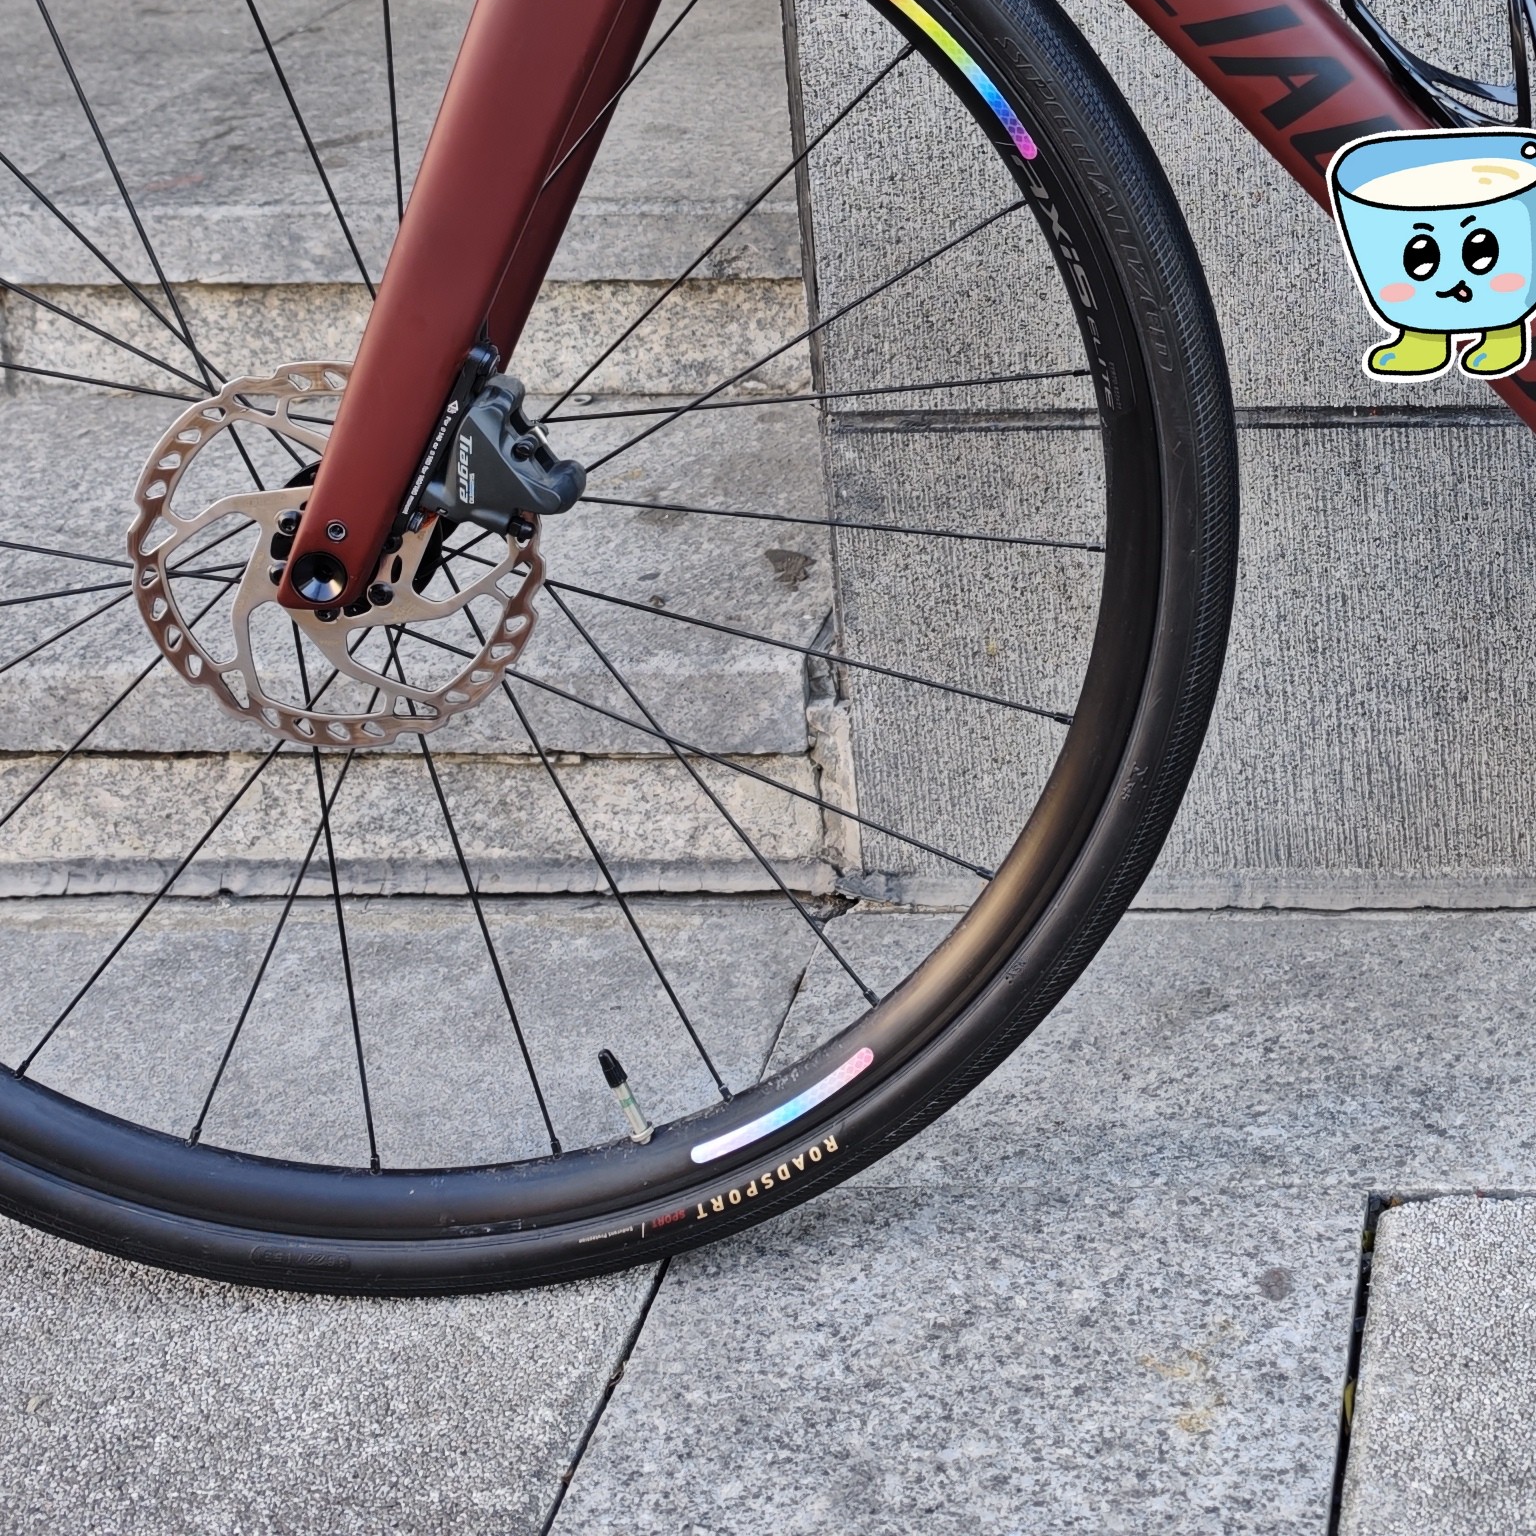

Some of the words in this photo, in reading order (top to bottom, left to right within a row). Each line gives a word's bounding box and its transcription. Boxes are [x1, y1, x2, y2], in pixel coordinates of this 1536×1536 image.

[1086, 315, 1116, 412] ELITE
[457, 434, 473, 504] Tiagra
[696, 1134, 839, 1221] ROADSPORT
[651, 1208, 687, 1230] SPORT
